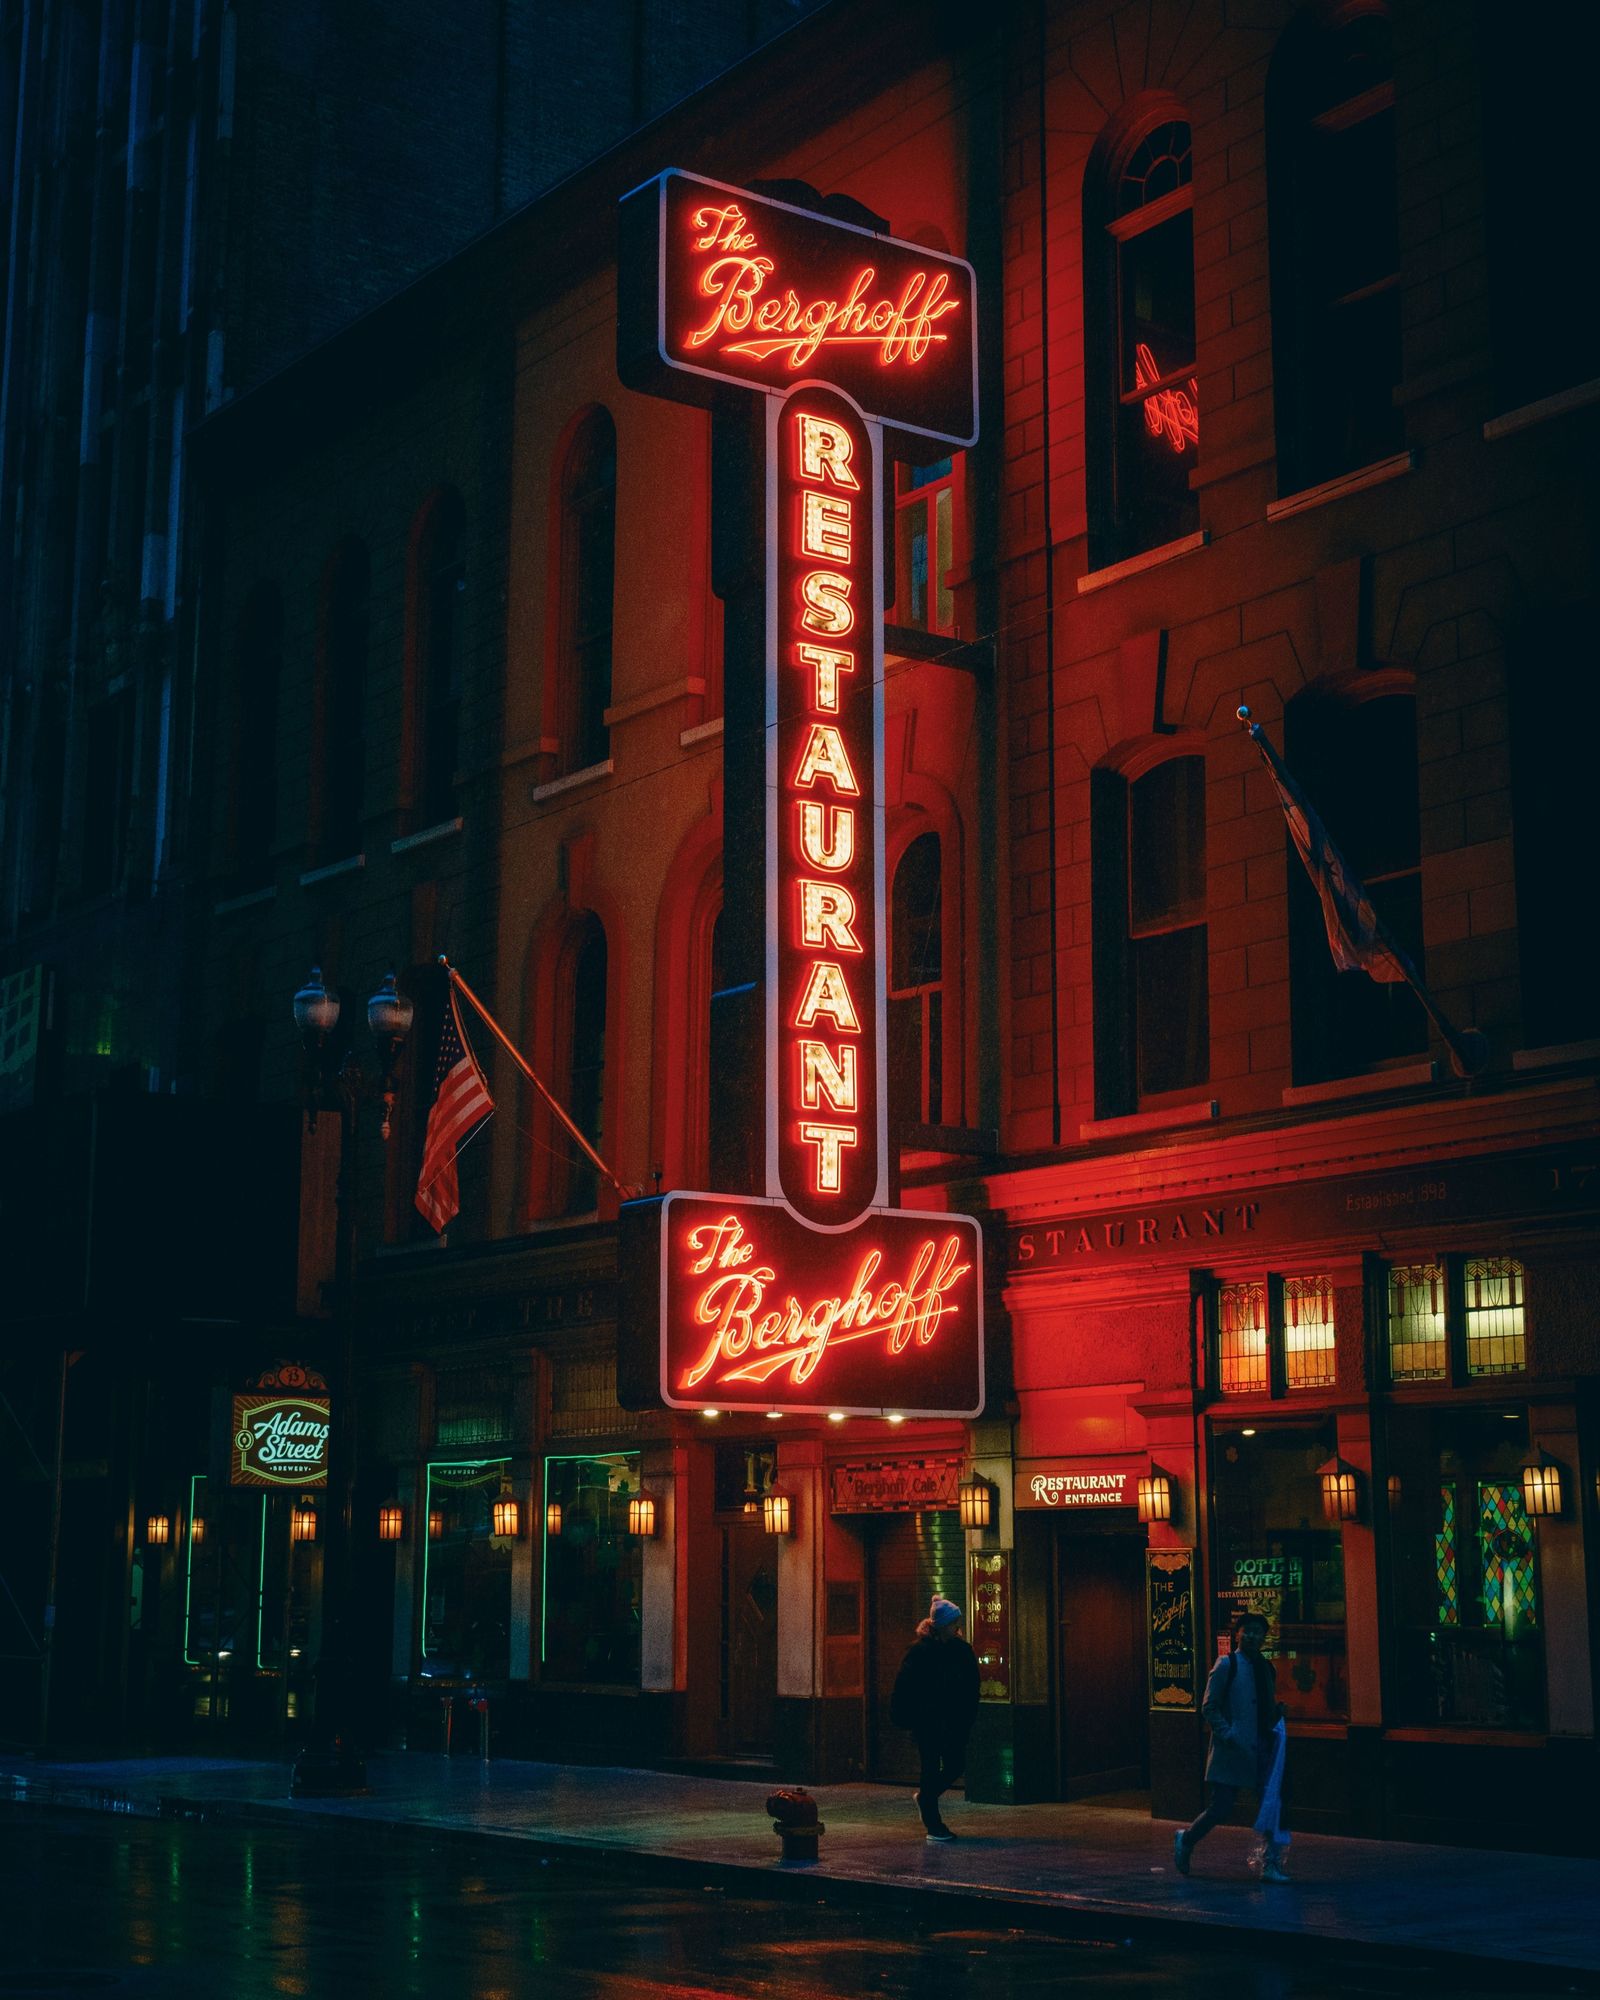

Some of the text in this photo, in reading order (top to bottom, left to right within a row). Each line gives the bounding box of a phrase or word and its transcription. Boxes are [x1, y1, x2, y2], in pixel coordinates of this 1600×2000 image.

[691, 205, 757, 251] The
[684, 256, 960, 369] Berghoff
[796, 413, 863, 1194] RESTAURANT
[687, 1215, 753, 1275] The
[678, 1235, 971, 1390] Berghoff
[253, 1411, 330, 1440] Adams
[258, 1434, 324, 1462] Street
[1030, 1474, 1127, 1505] RESTAURANT
[1064, 1492, 1122, 1504] ENTRANCE
[1152, 1582, 1175, 1600] THE
[1153, 1591, 1189, 1632] Berghoff
